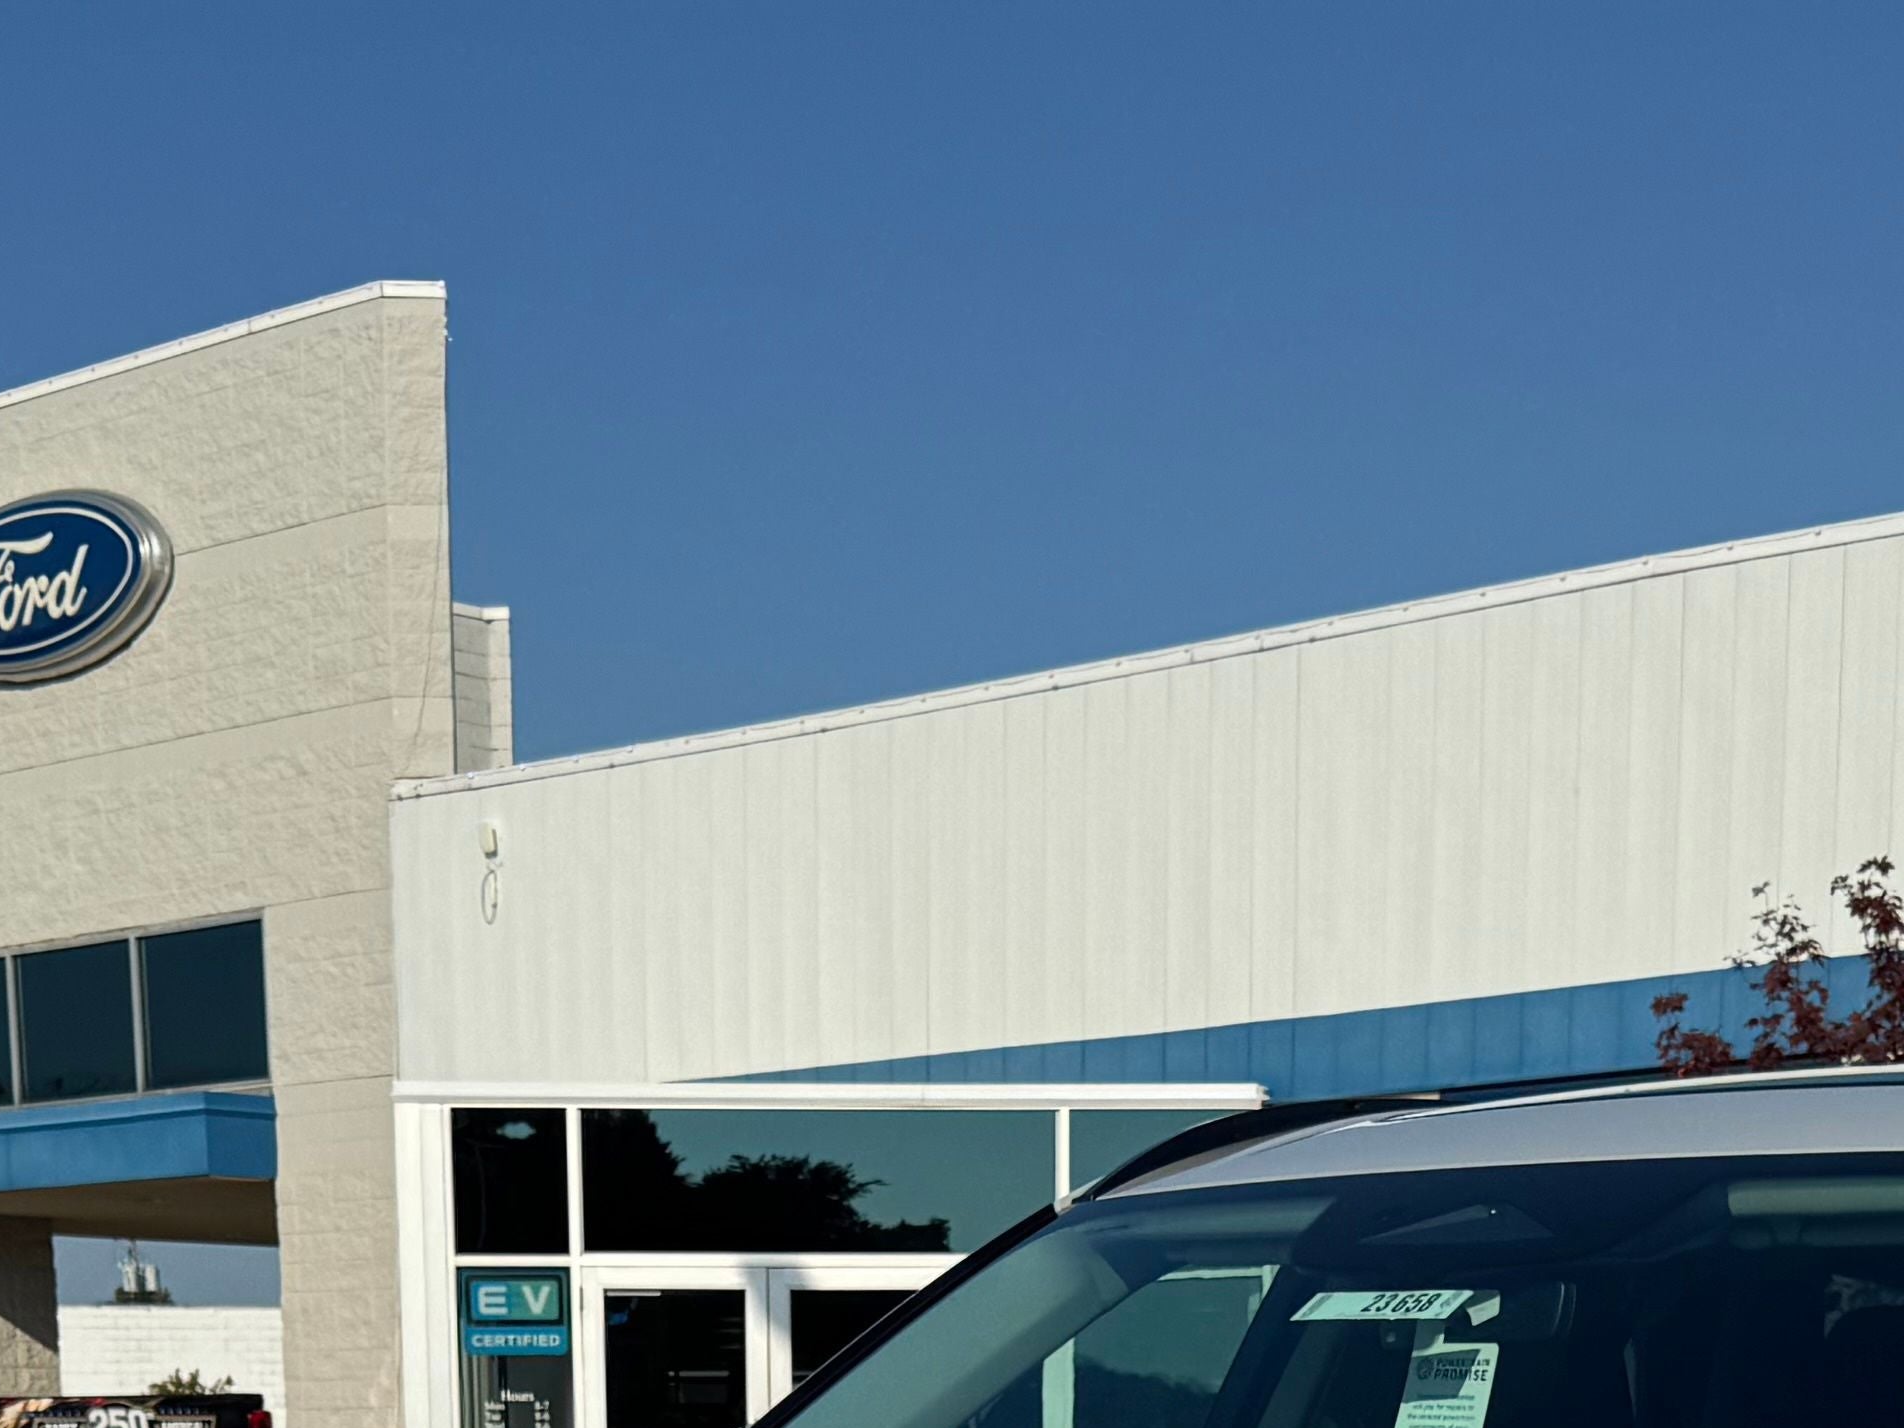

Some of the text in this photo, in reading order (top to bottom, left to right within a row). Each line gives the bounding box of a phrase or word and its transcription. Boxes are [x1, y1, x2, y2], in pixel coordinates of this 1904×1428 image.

[1360, 1292, 1442, 1313] 23658
[471, 1335, 561, 1347] CERTIFIED
[1433, 1368, 1489, 1382] PROMISE
[500, 1389, 535, 1402] Hours
